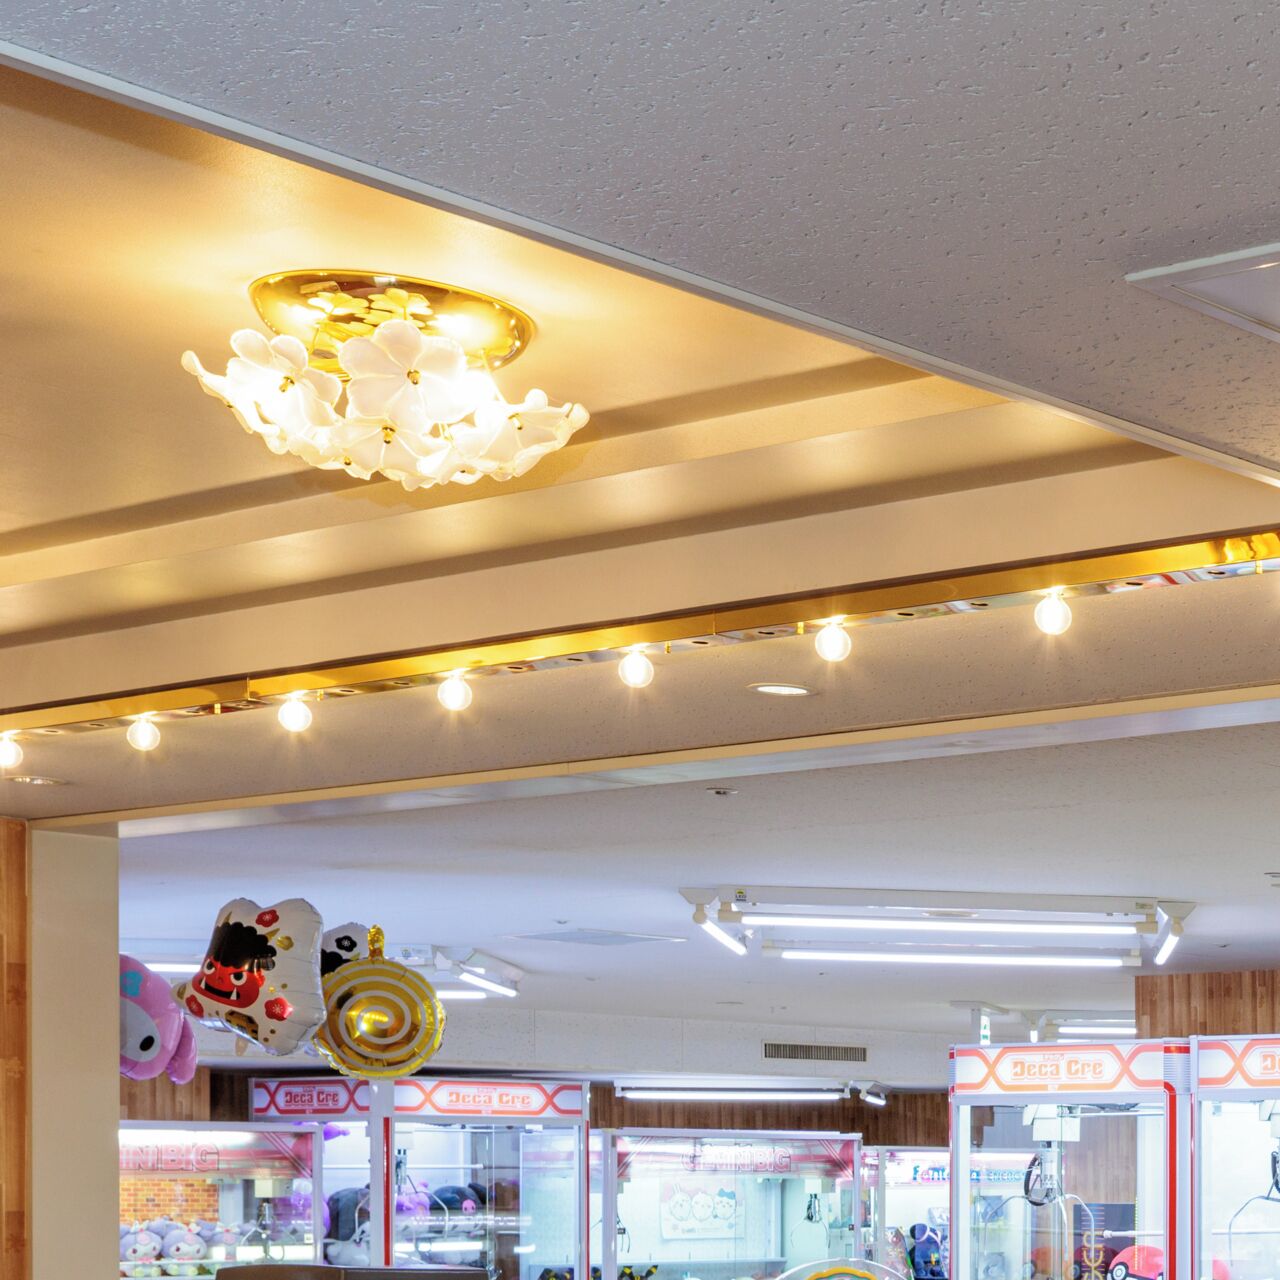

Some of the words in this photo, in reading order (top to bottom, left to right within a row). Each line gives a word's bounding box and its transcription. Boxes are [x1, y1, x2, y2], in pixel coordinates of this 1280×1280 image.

[1011, 1060, 1060, 1078] Deca
[1066, 1059, 1103, 1077] Cre
[284, 1090, 314, 1105] Deca
[447, 1090, 493, 1105] Deca
[498, 1090, 533, 1106] Cre
[160, 1143, 220, 1172] BIG
[753, 1146, 792, 1172] BIG
